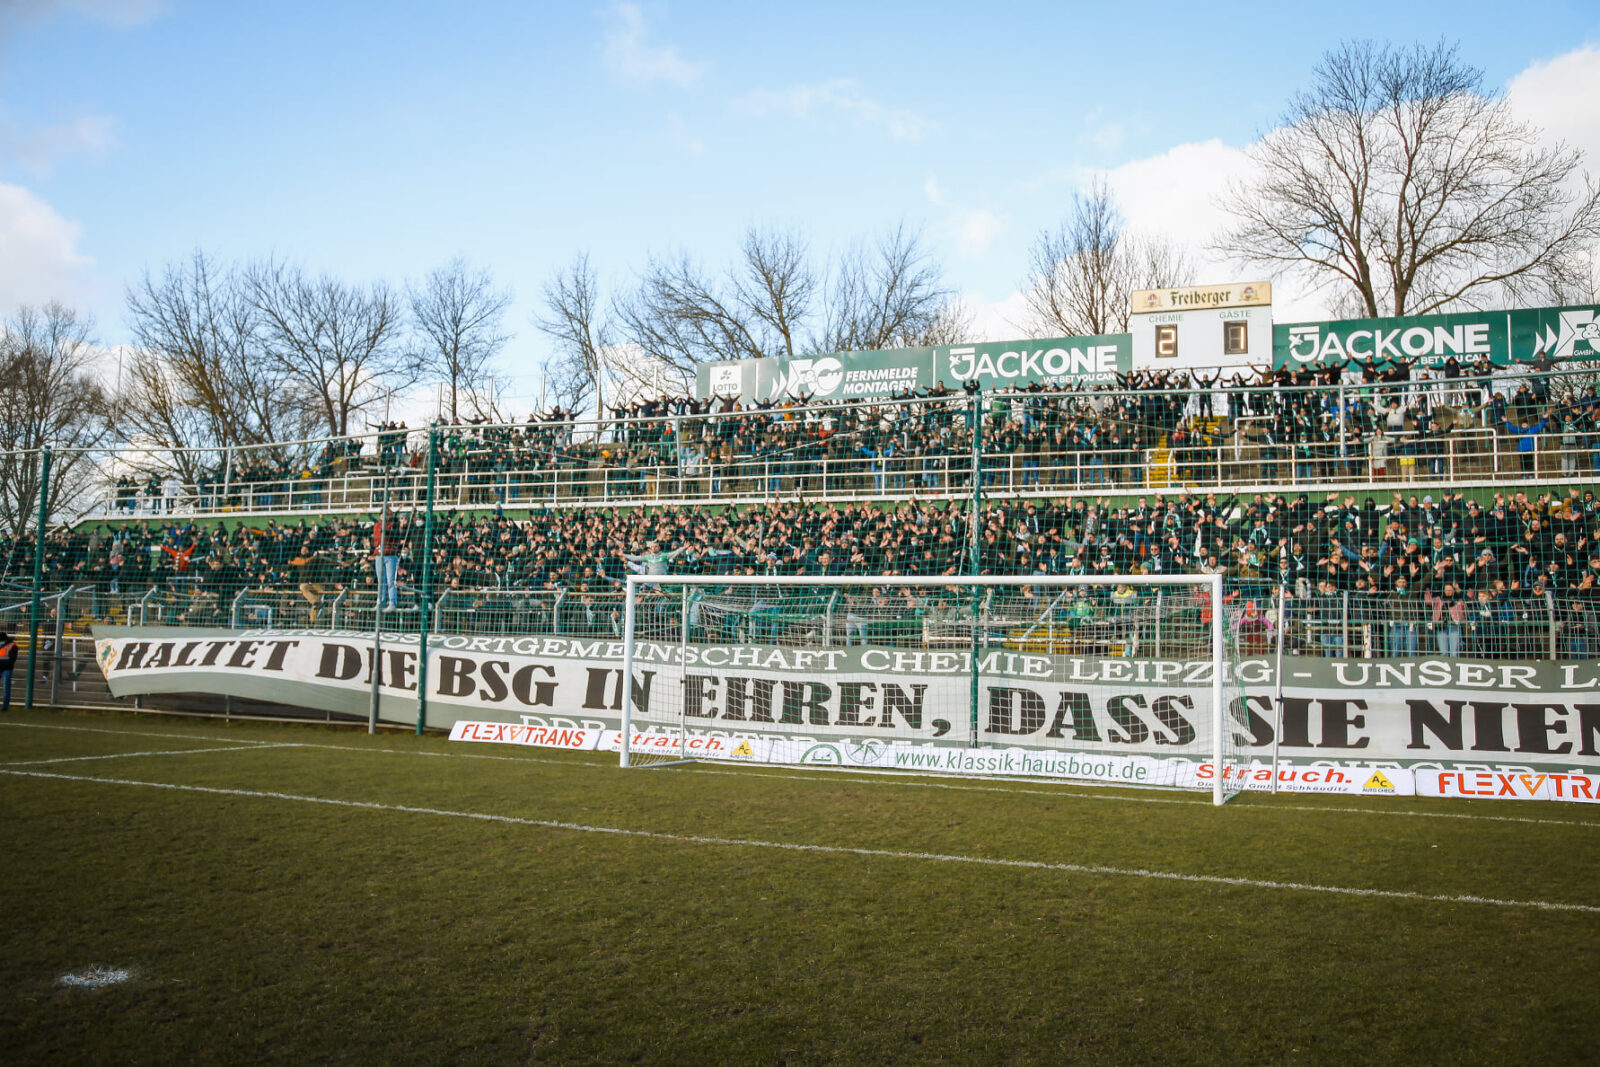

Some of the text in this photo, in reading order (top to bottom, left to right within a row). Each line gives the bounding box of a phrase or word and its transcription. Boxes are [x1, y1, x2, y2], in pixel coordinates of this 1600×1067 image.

[1170, 291, 1231, 306] Freiberger
[1149, 313, 1184, 323] CHEMIE
[1159, 329, 1176, 354] 2
[1288, 323, 1491, 362] JACKONE
[949, 344, 1118, 380] JACKONE
[1420, 355, 1440, 365] BET
[846, 367, 918, 382] FERNMELDE
[1043, 376, 1059, 384] WE
[1059, 375, 1075, 383] BET
[1076, 373, 1095, 382] YOU
[712, 383, 738, 391] LOTTO
[842, 378, 916, 394] MONTAGEN
[860, 649, 1054, 678] CHEMIE
[1069, 658, 1275, 684] LEIPZIG
[1330, 660, 1542, 690] UNSER
[1560, 664, 1600, 689] L
[114, 641, 299, 671] HALTET
[315, 643, 418, 691] DIE
[436, 655, 559, 706] BSG
[582, 667, 657, 713] IN
[679, 674, 952, 738] EHREN,
[984, 686, 1197, 746] DASS
[1230, 695, 1371, 749] SIE
[895, 751, 1148, 781] www.klassik-hausboot.de
[1196, 764, 1352, 784] Strauch.
